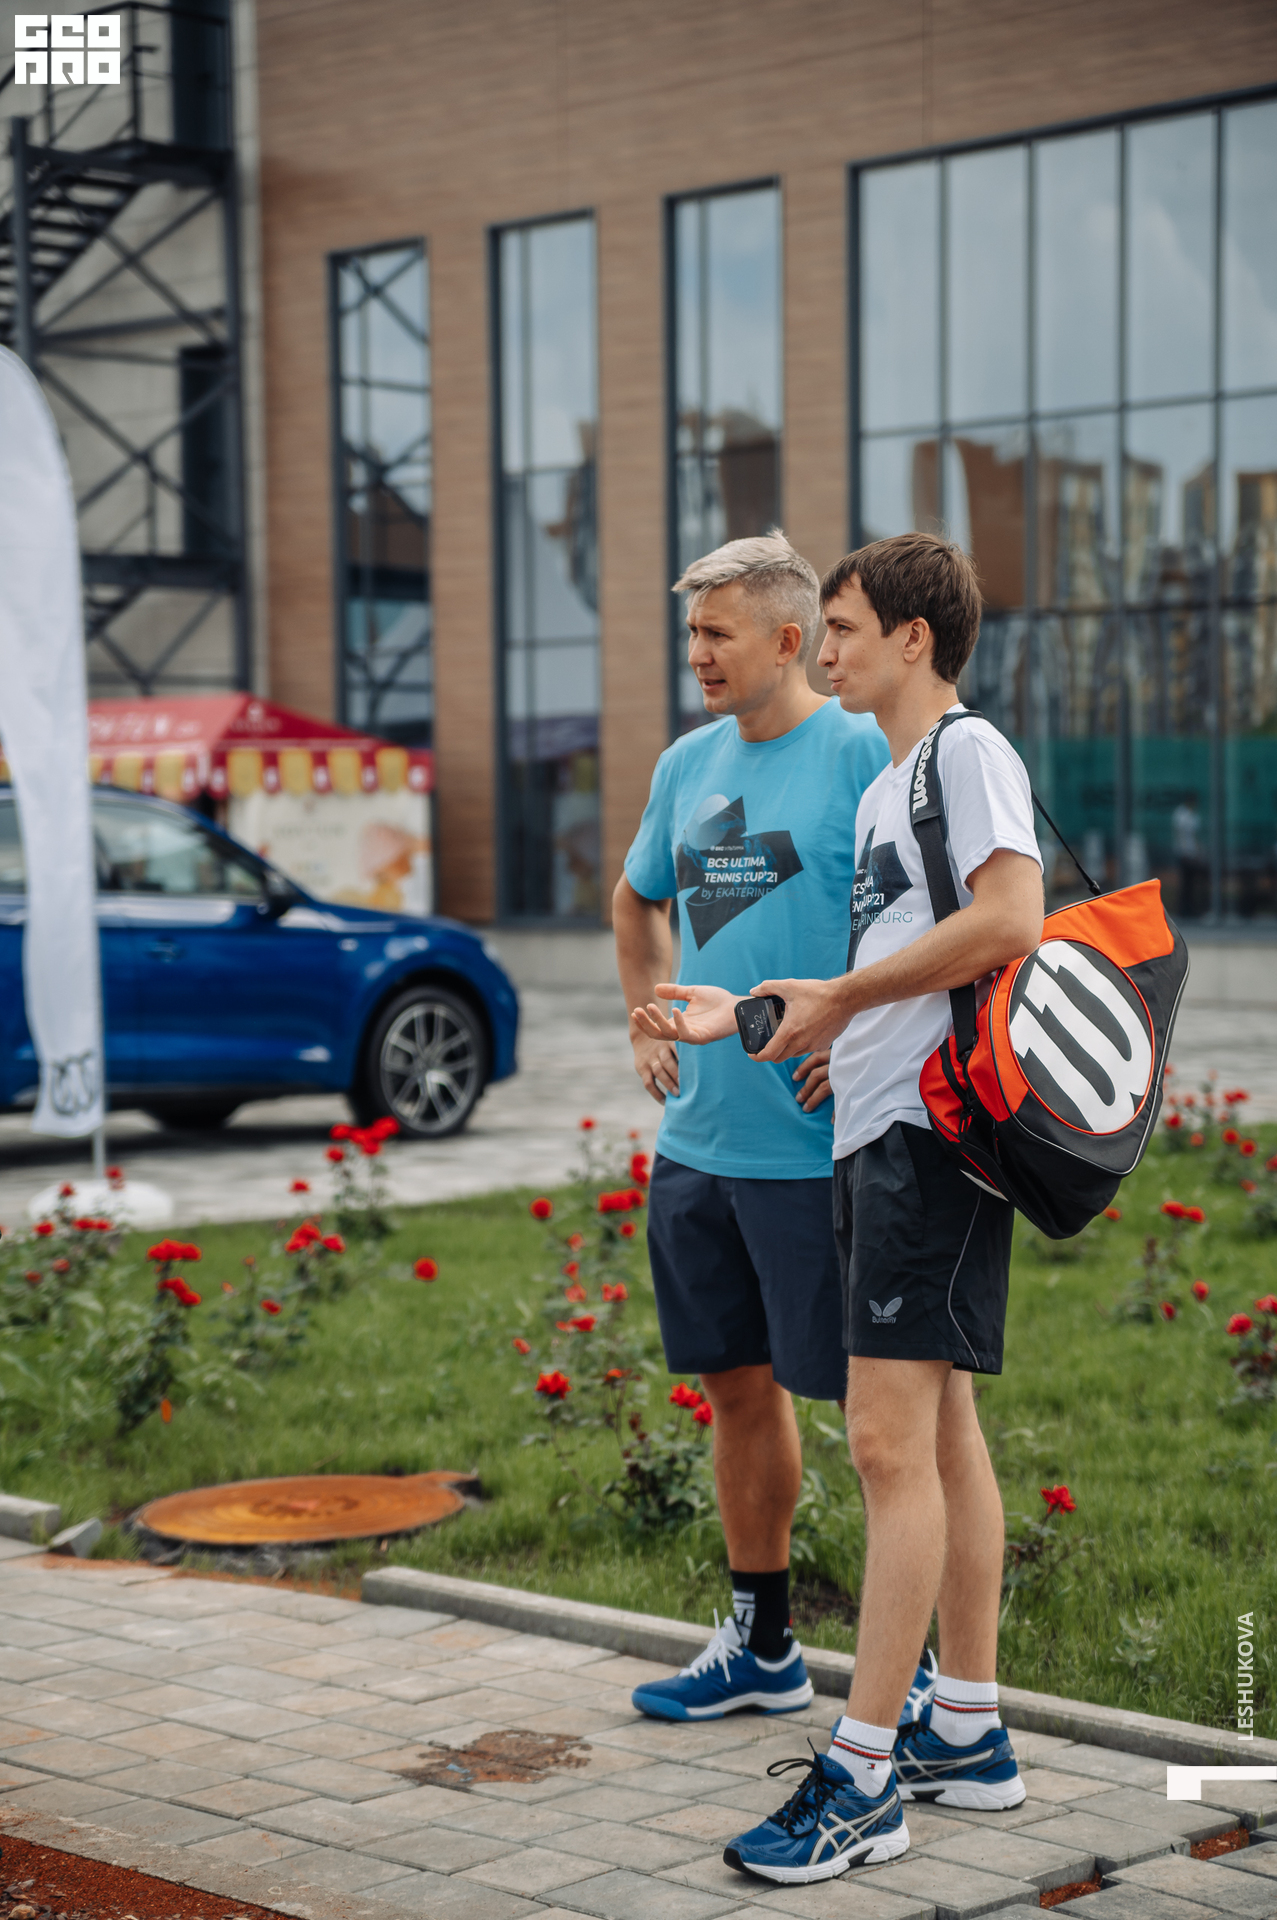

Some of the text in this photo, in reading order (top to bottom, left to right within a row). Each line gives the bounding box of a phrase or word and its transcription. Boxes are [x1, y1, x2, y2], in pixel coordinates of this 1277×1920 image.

[707, 856, 766, 868] BCS ULTIMA
[704, 871, 778, 883] TENNIS CUP'21
[701, 887, 714, 900] by
